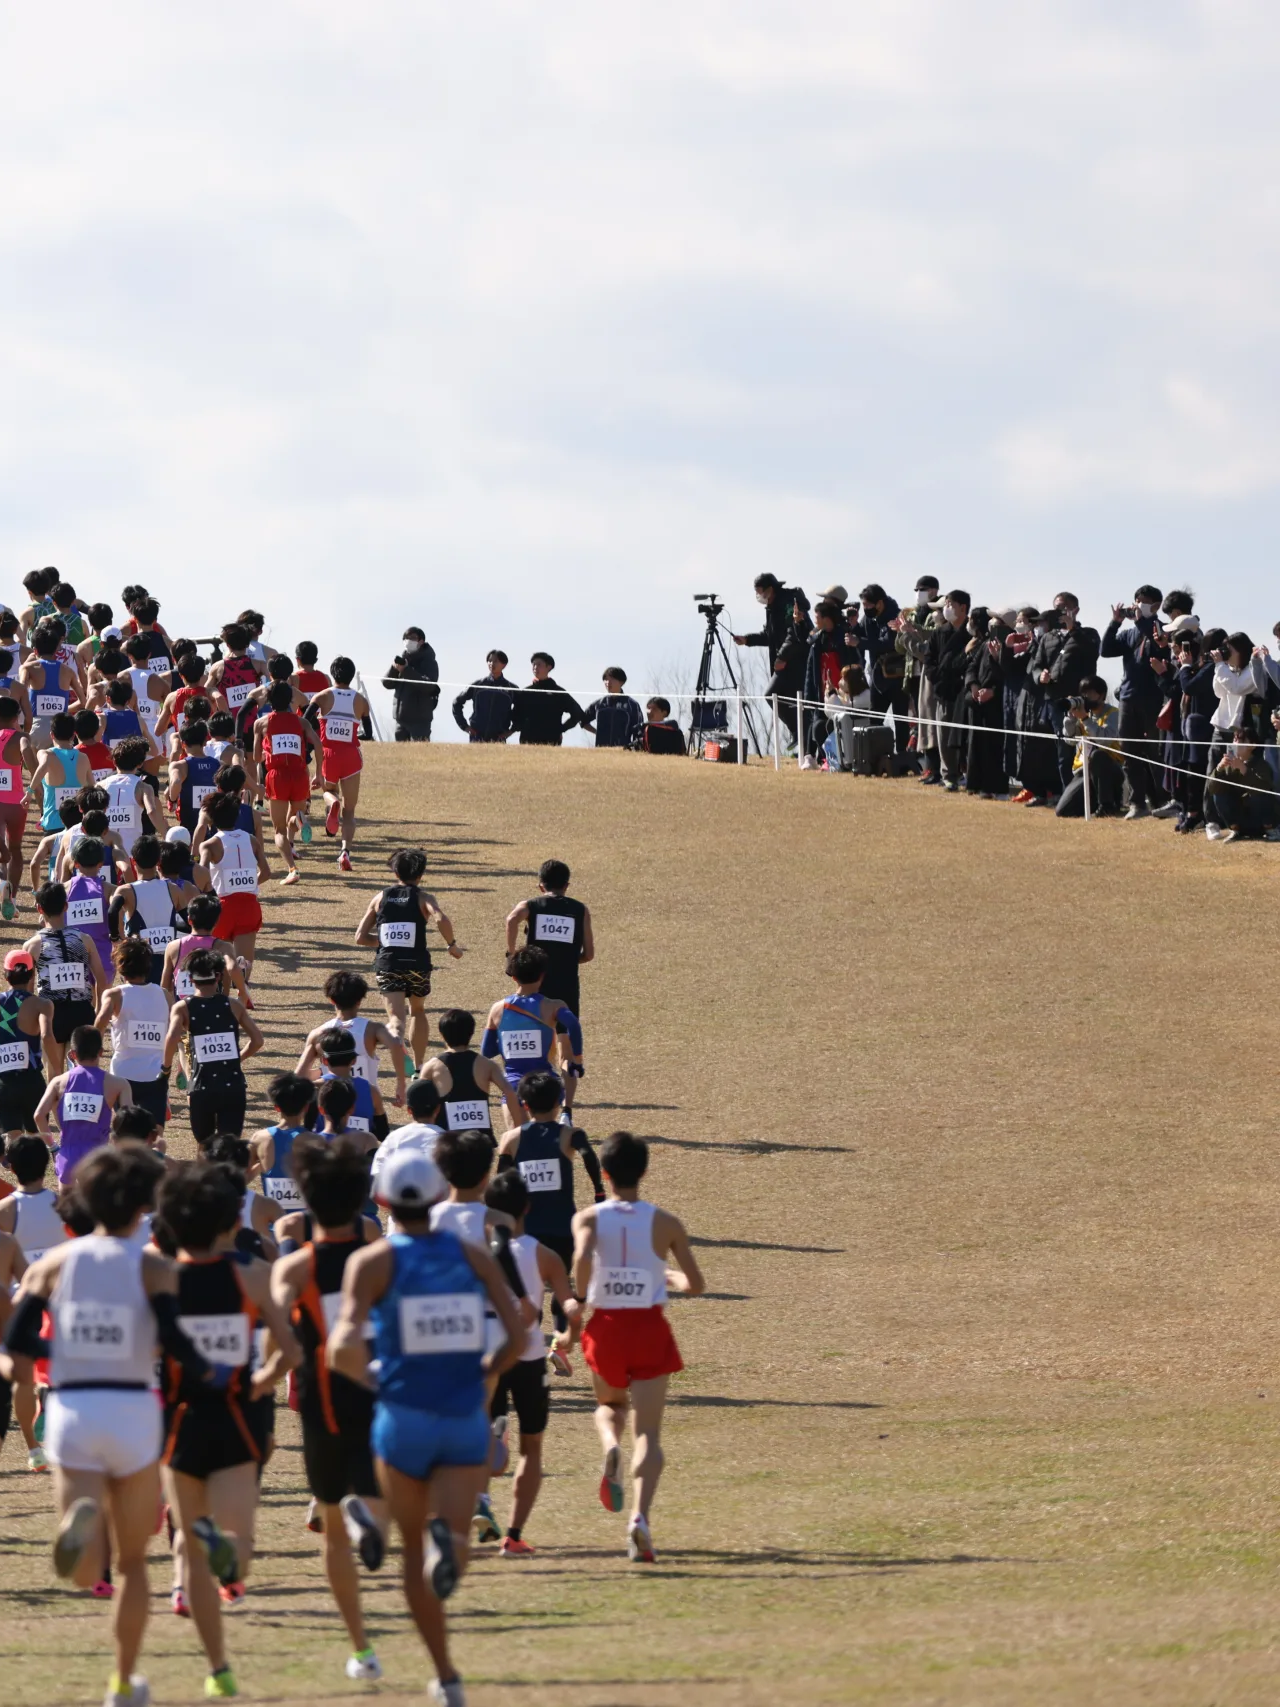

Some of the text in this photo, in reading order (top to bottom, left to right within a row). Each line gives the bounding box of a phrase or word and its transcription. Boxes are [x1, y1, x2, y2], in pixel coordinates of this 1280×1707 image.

[231, 692, 250, 702] 107
[40, 702, 63, 711] 1063
[328, 726, 350, 736] 1082
[276, 740, 299, 750] 1138
[228, 876, 254, 886] 1006
[72, 908, 98, 918] 1134
[541, 924, 570, 935] 1047
[384, 931, 410, 940] 1059
[54, 972, 82, 983] 1117
[133, 1031, 161, 1042] 1100
[204, 1036, 226, 1044] MIT
[0, 1044, 20, 1054] MIT
[201, 1042, 232, 1055] 1032
[506, 1040, 536, 1052] 1155
[67, 1102, 96, 1114] 1133
[456, 1102, 478, 1110] MIT
[453, 1110, 484, 1122] 1065
[524, 1162, 548, 1171] MIT
[523, 1171, 554, 1183] 1017
[272, 1180, 295, 1189] MIT
[270, 1190, 301, 1200] 1044
[610, 1271, 640, 1280] MIT
[603, 1282, 646, 1297] 1007
[413, 1316, 475, 1337] 1053
[194, 1336, 240, 1352] 145
